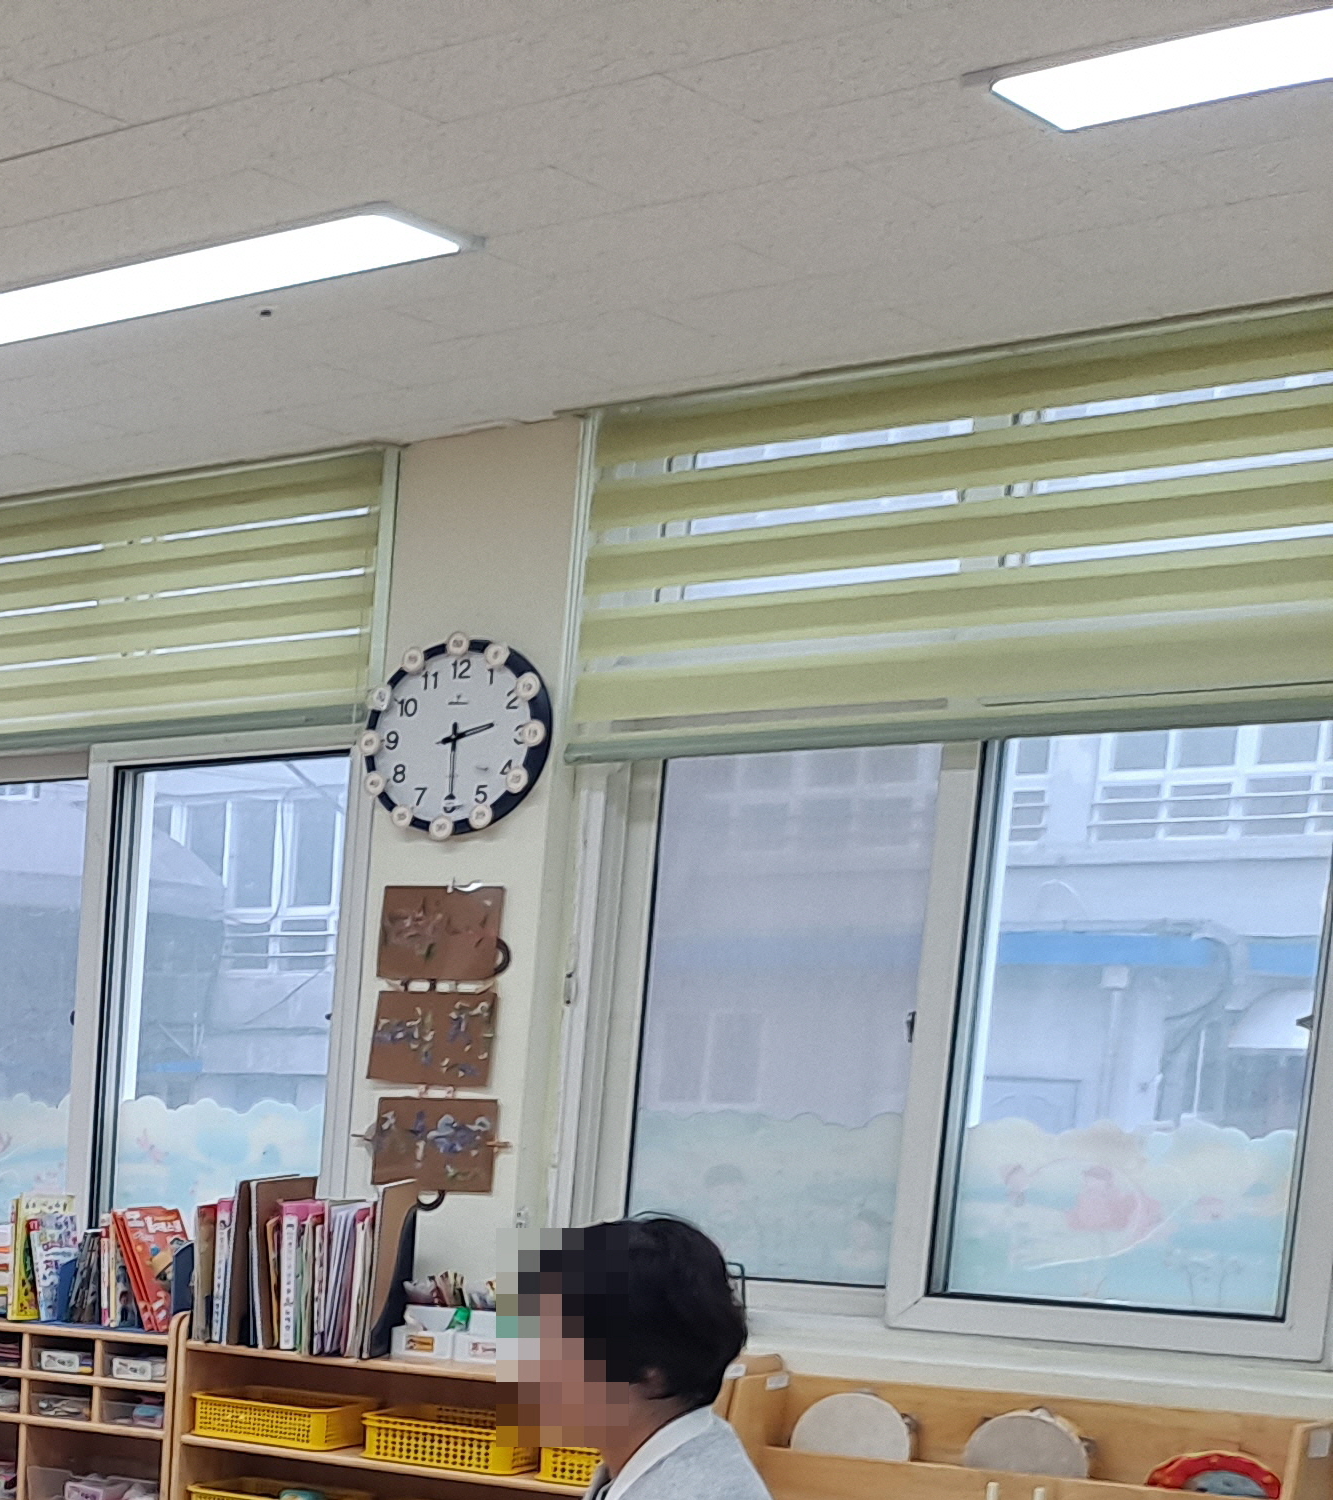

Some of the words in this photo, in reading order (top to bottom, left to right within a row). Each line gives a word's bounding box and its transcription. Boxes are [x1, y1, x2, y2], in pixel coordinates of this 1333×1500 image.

[451, 659, 471, 679] 12
[487, 668, 495, 685] 1
[422, 671, 438, 690] 11
[397, 698, 417, 717] 10
[506, 689, 519, 709] 2
[385, 731, 399, 750] 9
[392, 764, 406, 783] 8
[414, 787, 427, 806] 7
[474, 785, 488, 804] 5
